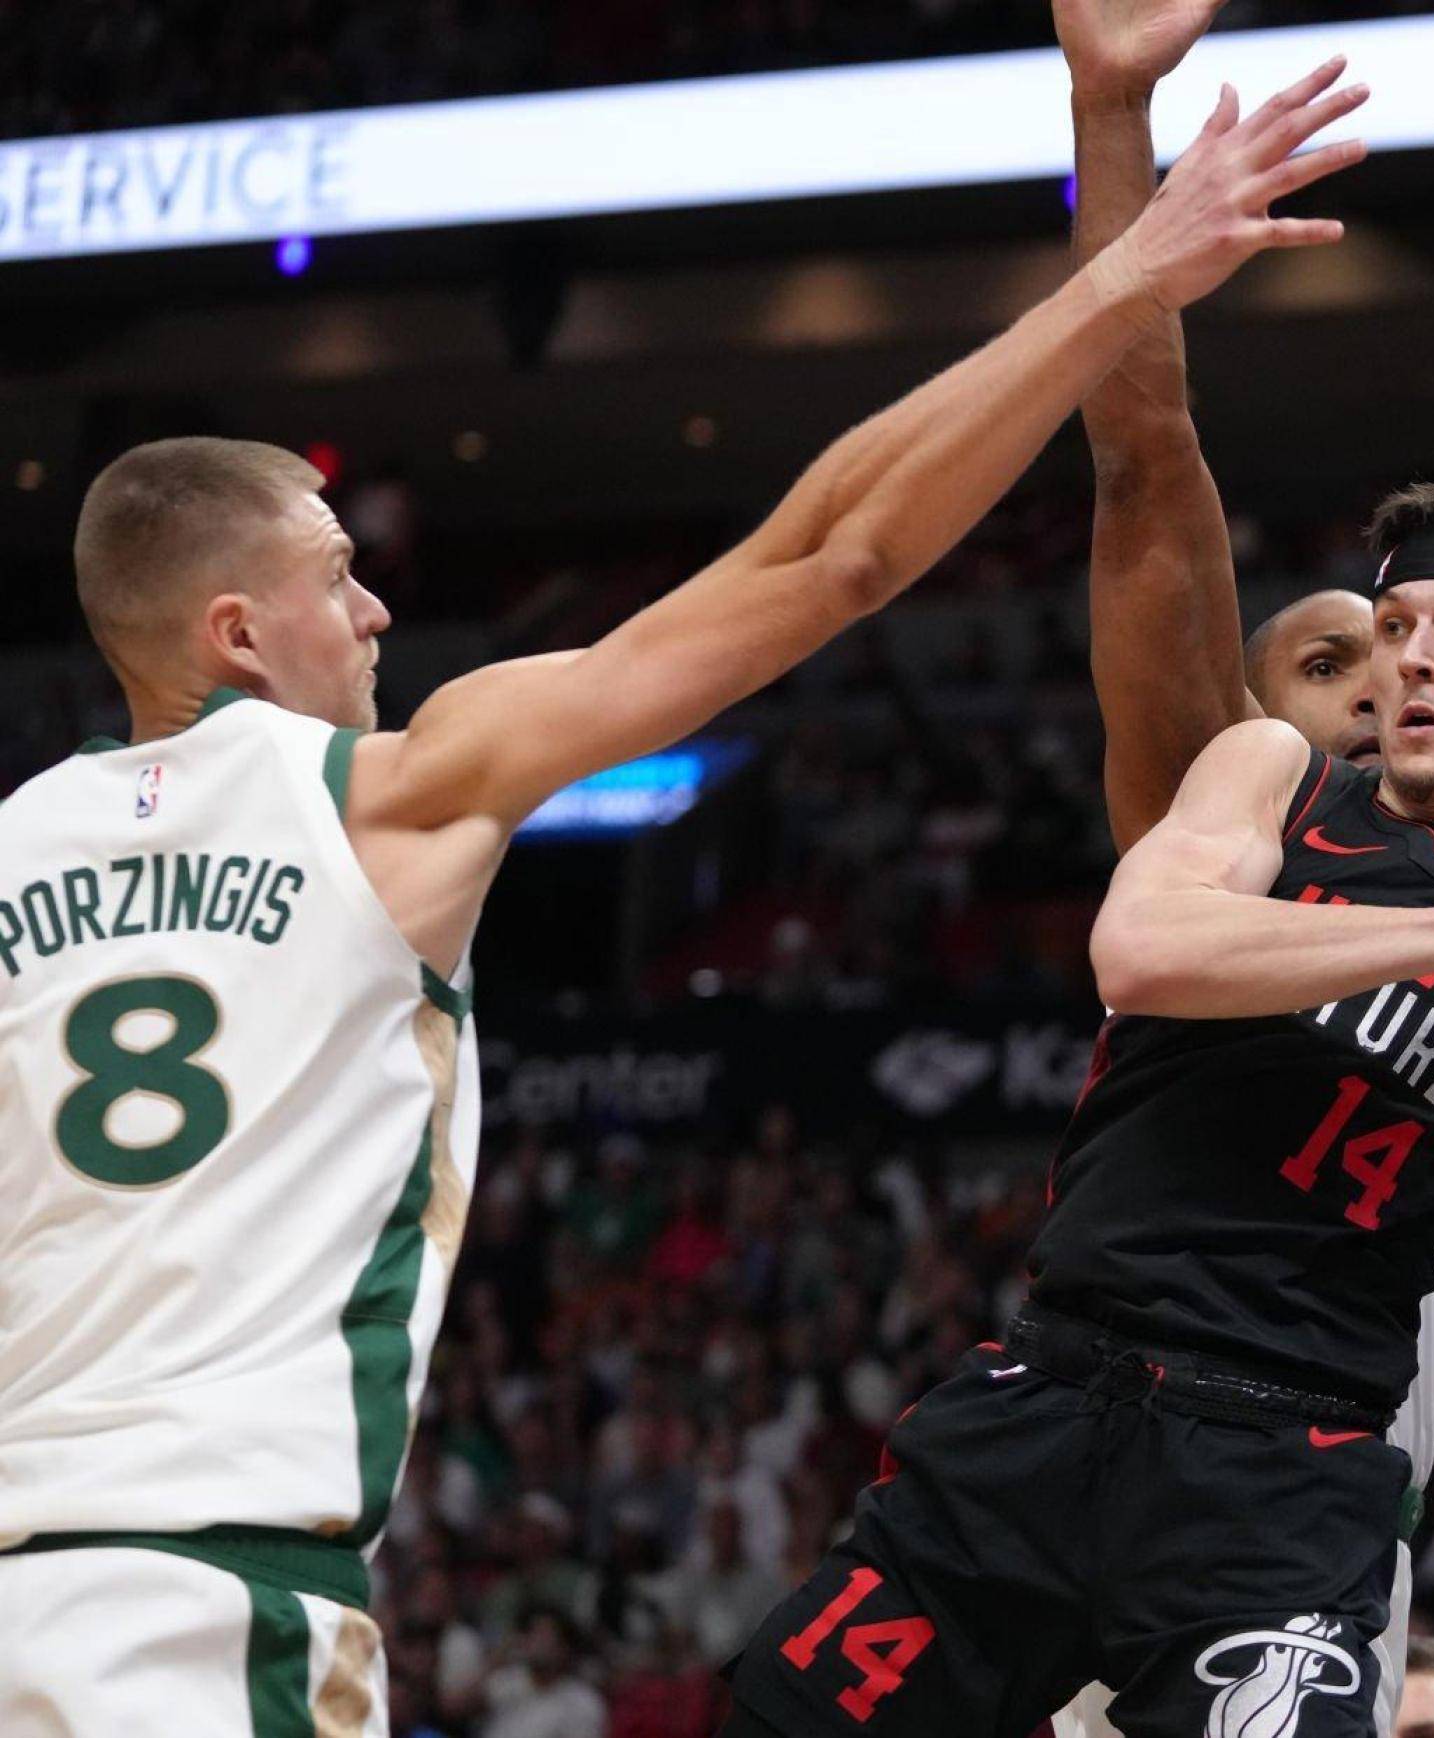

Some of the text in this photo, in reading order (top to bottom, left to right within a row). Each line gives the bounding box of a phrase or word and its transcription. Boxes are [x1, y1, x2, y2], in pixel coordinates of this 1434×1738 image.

[0, 136, 347, 232] ERVICE
[0, 852, 305, 978] PORZINGIS
[53, 971, 234, 1191] 8
[1279, 1075, 1426, 1231] 14
[780, 1567, 935, 1723] 14
